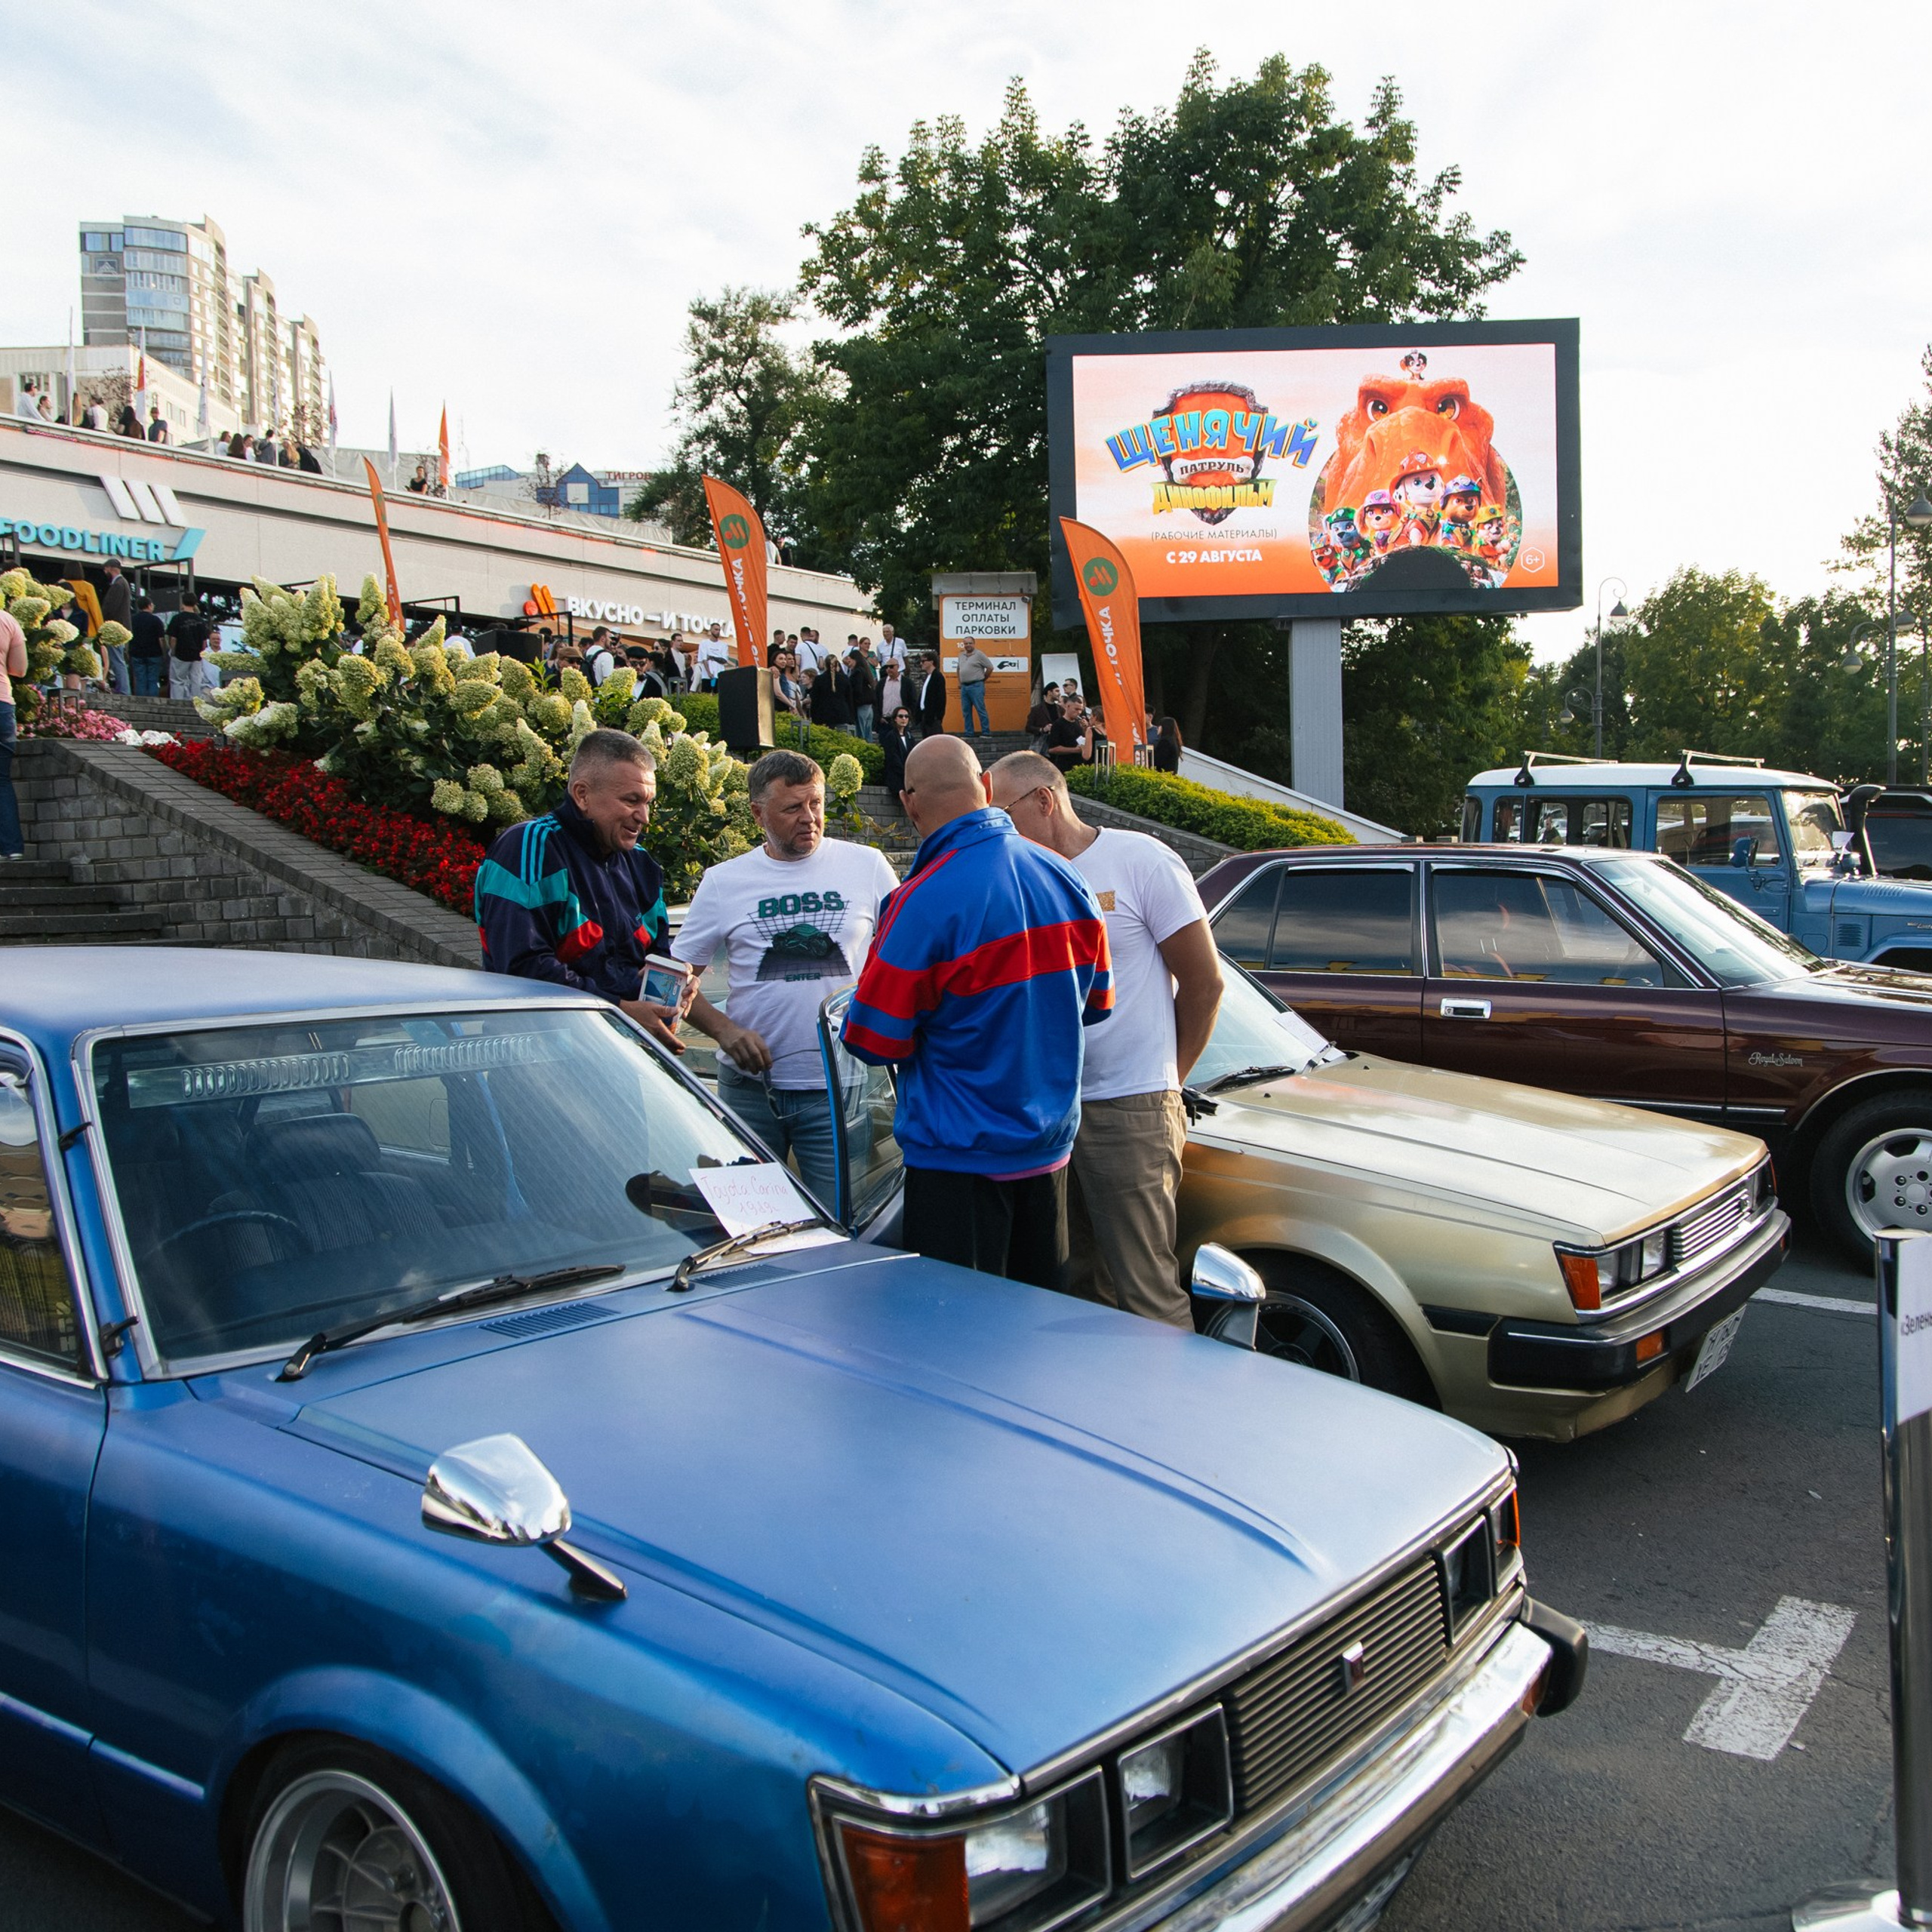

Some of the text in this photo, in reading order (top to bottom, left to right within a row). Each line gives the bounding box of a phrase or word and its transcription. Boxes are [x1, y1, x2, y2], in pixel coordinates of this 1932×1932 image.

[1105, 409, 1320, 472] ЩЕНЯЧИЙ
[1180, 461, 1244, 475] ПАТРУЛЬ
[1150, 478, 1277, 515] ДИНОФИЛЬМ
[0, 517, 165, 562] FOODLINER
[1151, 529, 1278, 542] (РАБОЧИЕ МАТЕРИАЛЫ)
[1166, 549, 1263, 564] С 29 АВГУСТА
[1526, 554, 1540, 565] 6+
[567, 595, 644, 626] ВКУСНО
[955, 601, 1016, 611] ТЕРМИНАЛ
[961, 614, 1010, 623] ОПЛАТЫ
[955, 626, 1016, 635] ПАРКОВКИ
[758, 891, 844, 918] BOSS
[785, 972, 821, 982] ENTER
[700, 1176, 748, 1205] Toyota
